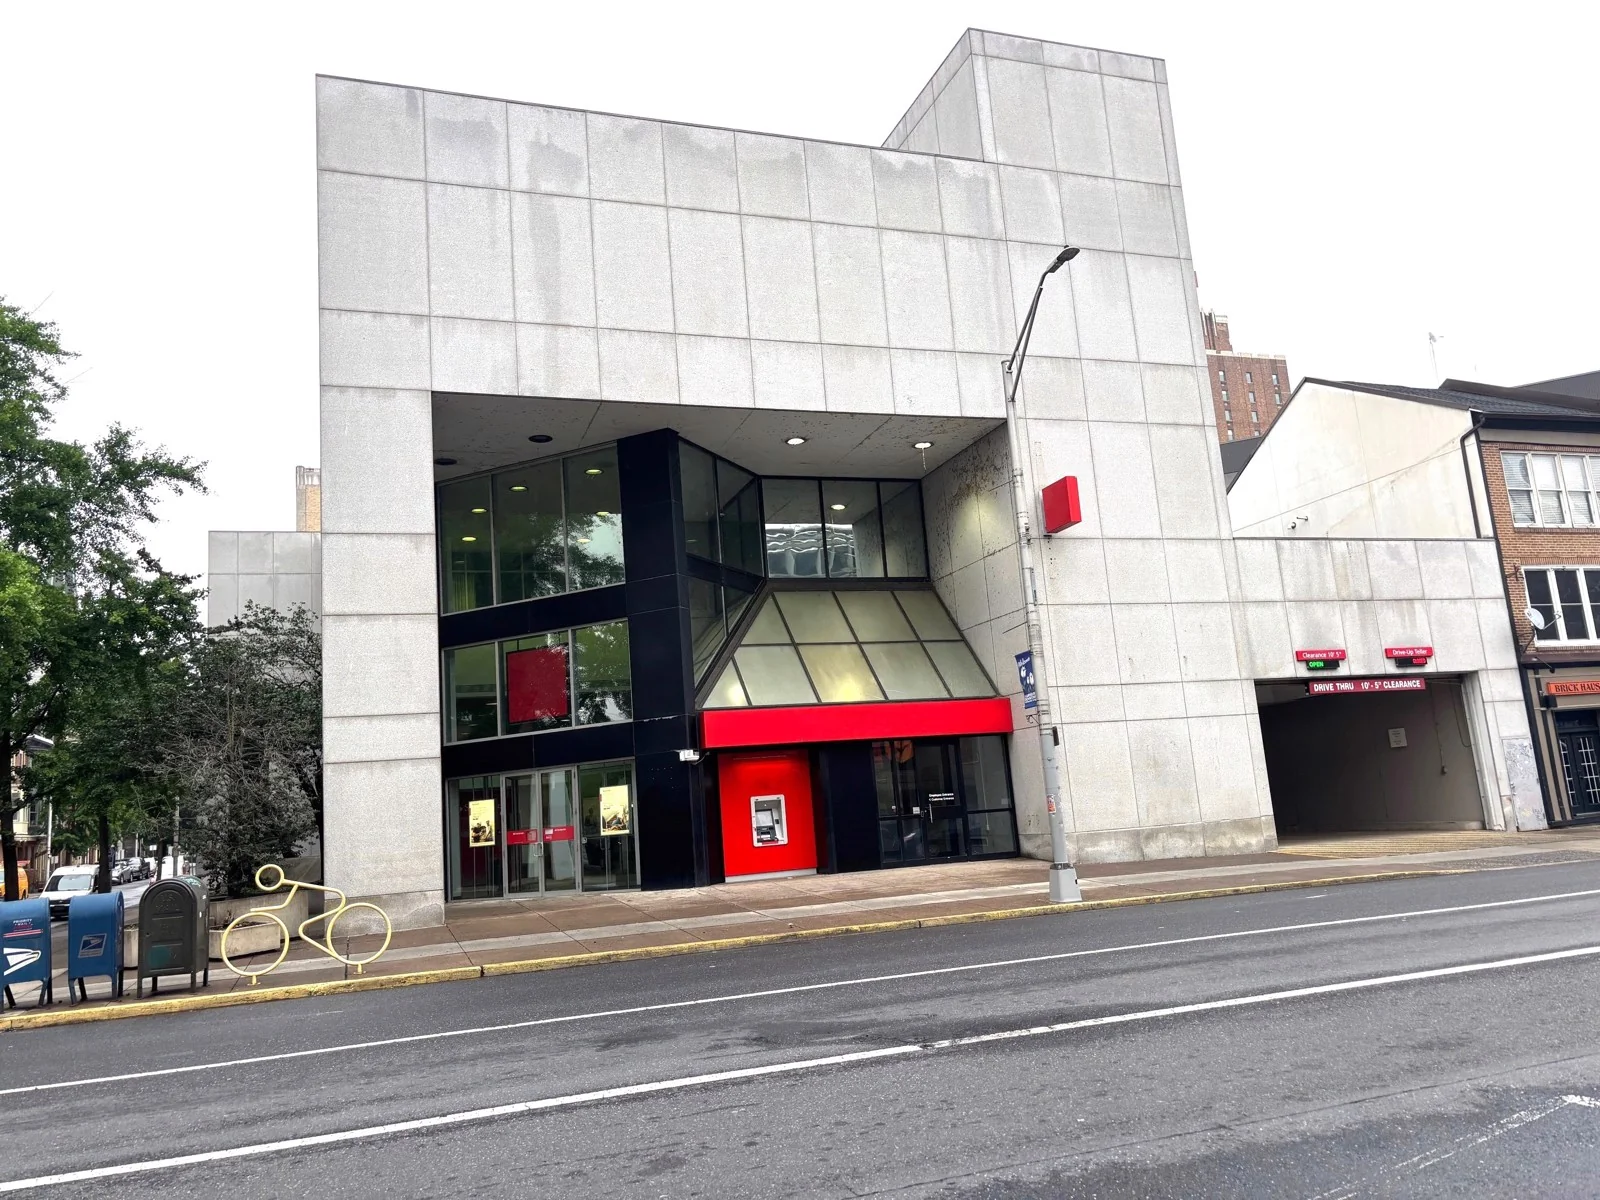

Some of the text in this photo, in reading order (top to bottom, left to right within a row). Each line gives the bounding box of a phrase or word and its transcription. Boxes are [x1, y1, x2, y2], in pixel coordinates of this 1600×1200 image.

[1313, 682, 1334, 692] DRIVE
[1336, 682, 1354, 691] THRU
[1383, 680, 1421, 689] CLEARANCE
[1555, 684, 1579, 692] BRICK
